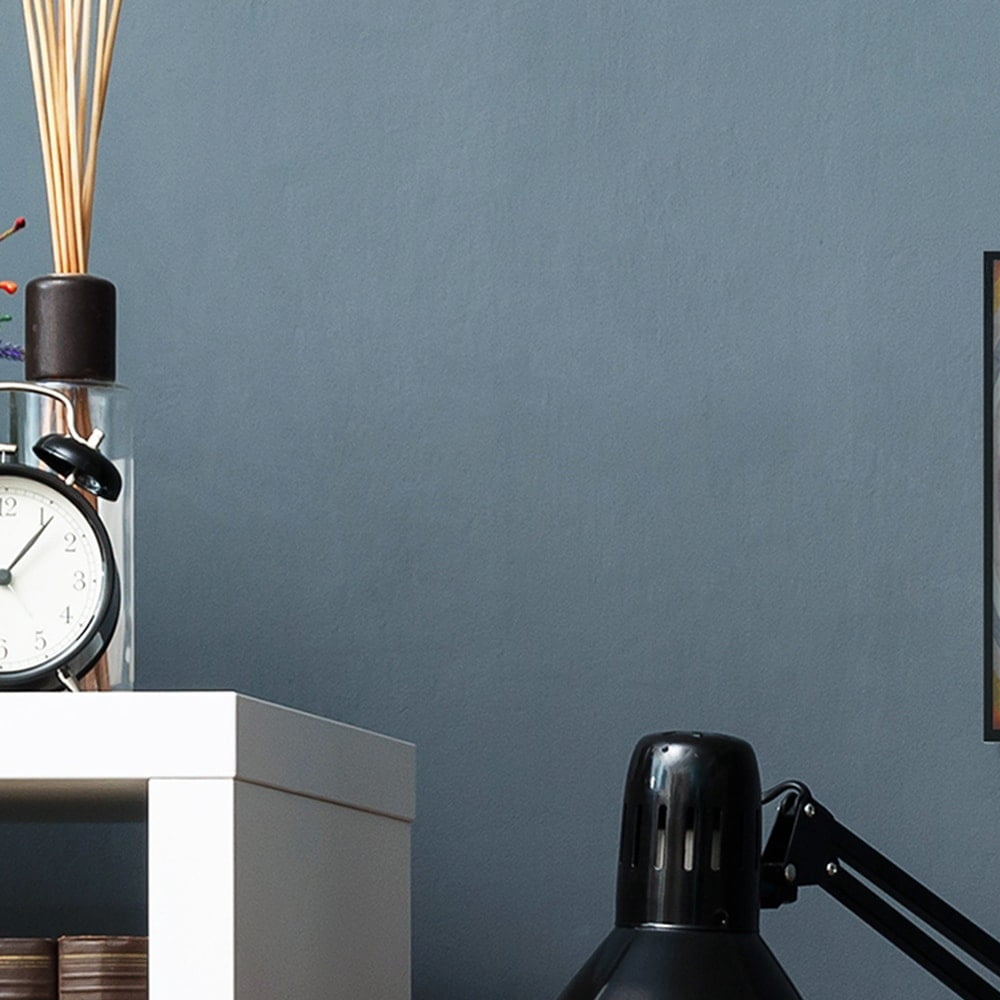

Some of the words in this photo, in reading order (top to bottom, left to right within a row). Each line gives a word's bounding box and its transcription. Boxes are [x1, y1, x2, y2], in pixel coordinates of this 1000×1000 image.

[64, 532, 77, 552] 2
[73, 571, 86, 591] 3
[60, 606, 74, 624] 4
[35, 630, 47, 651] 5
